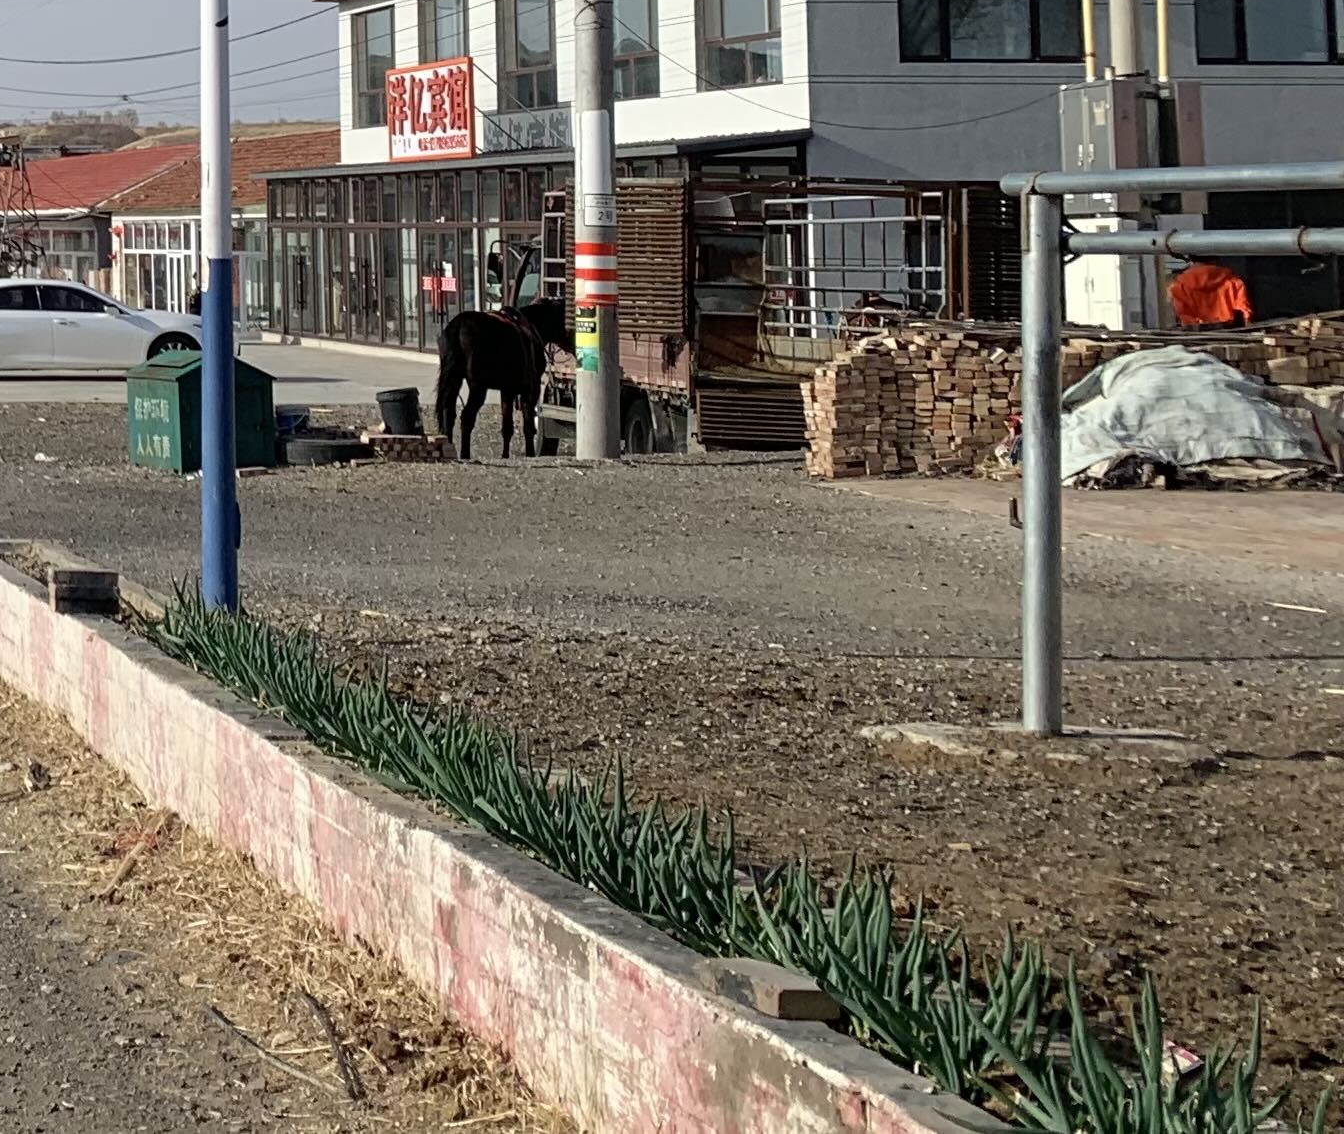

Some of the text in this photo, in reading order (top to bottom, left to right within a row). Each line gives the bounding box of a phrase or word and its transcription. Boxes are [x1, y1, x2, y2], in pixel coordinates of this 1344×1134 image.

[134, 396, 170, 423] 保护环境
[136, 434, 171, 458] 人人有责
